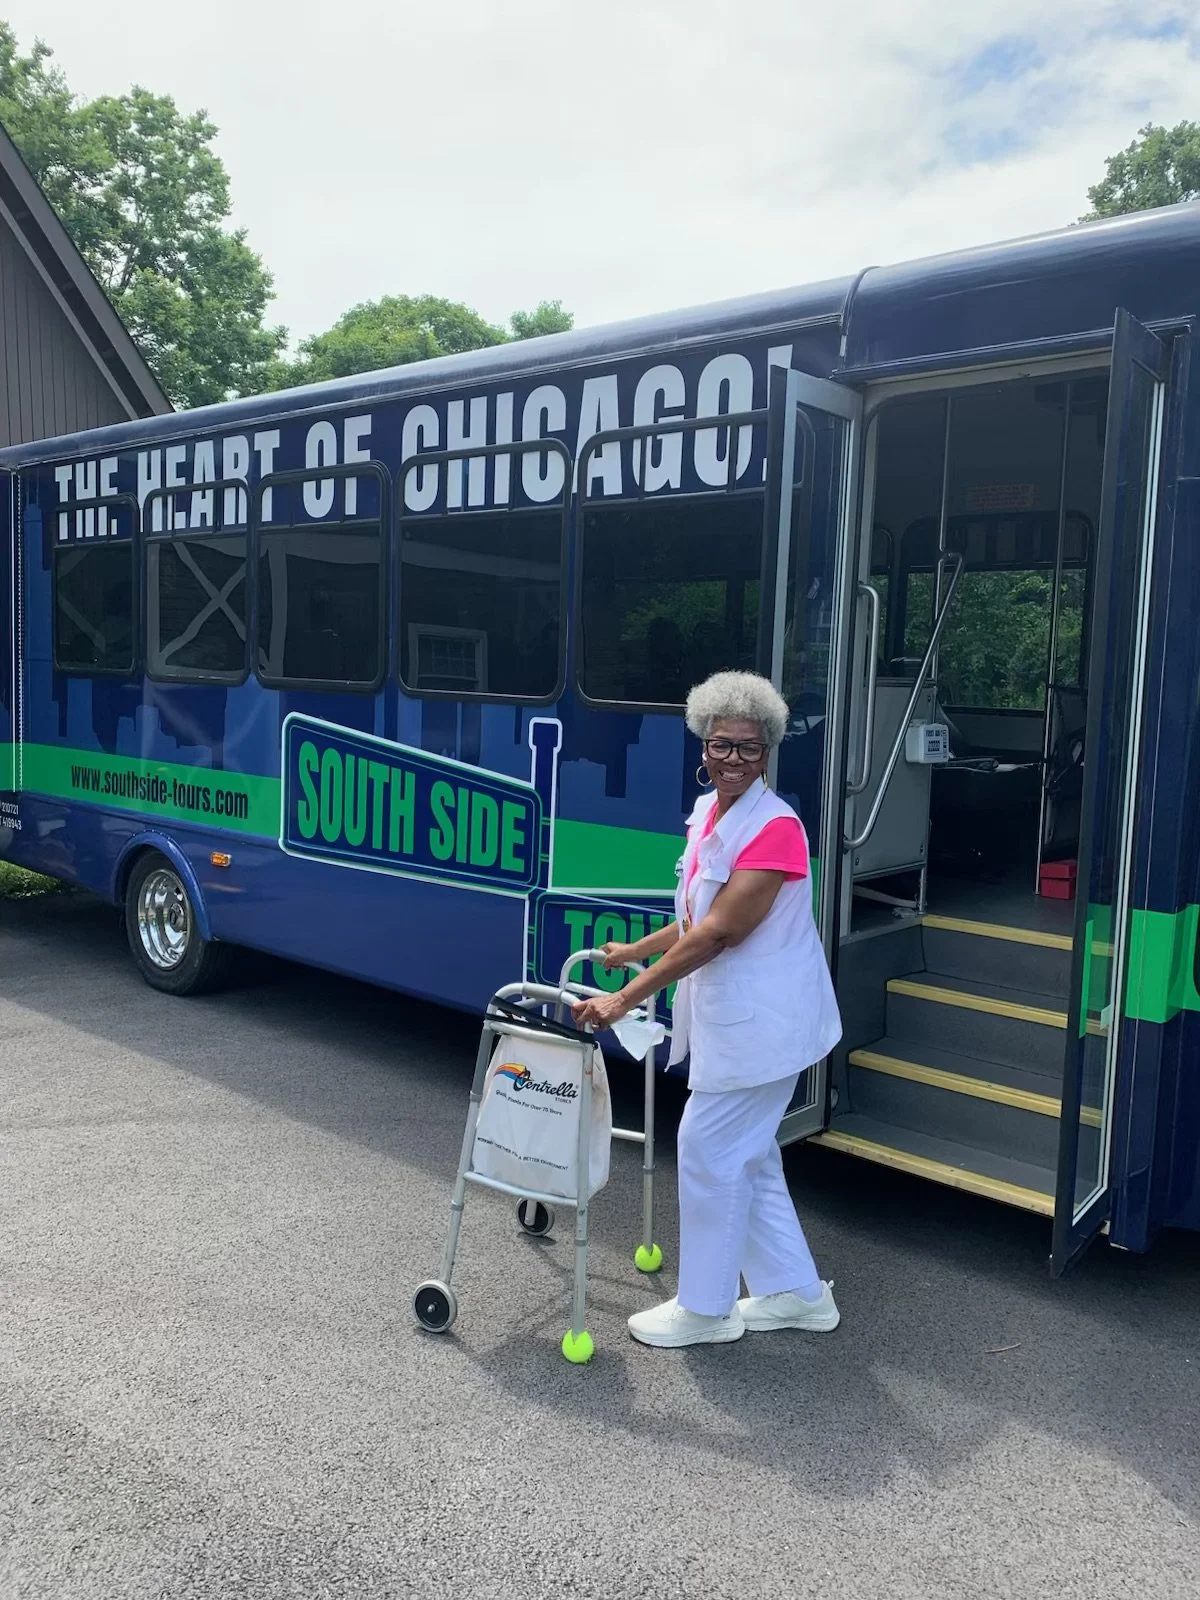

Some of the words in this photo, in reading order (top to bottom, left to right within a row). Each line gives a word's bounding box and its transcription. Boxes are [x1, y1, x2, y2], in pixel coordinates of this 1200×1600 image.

[55, 456, 119, 540] THE
[137, 429, 280, 533] HEART
[302, 414, 372, 518] OF
[71, 765, 249, 819] www.southside-tours.com
[298, 740, 416, 855] SOUTH
[429, 780, 526, 873] SIDE
[513, 1067, 578, 1098] Centrella
